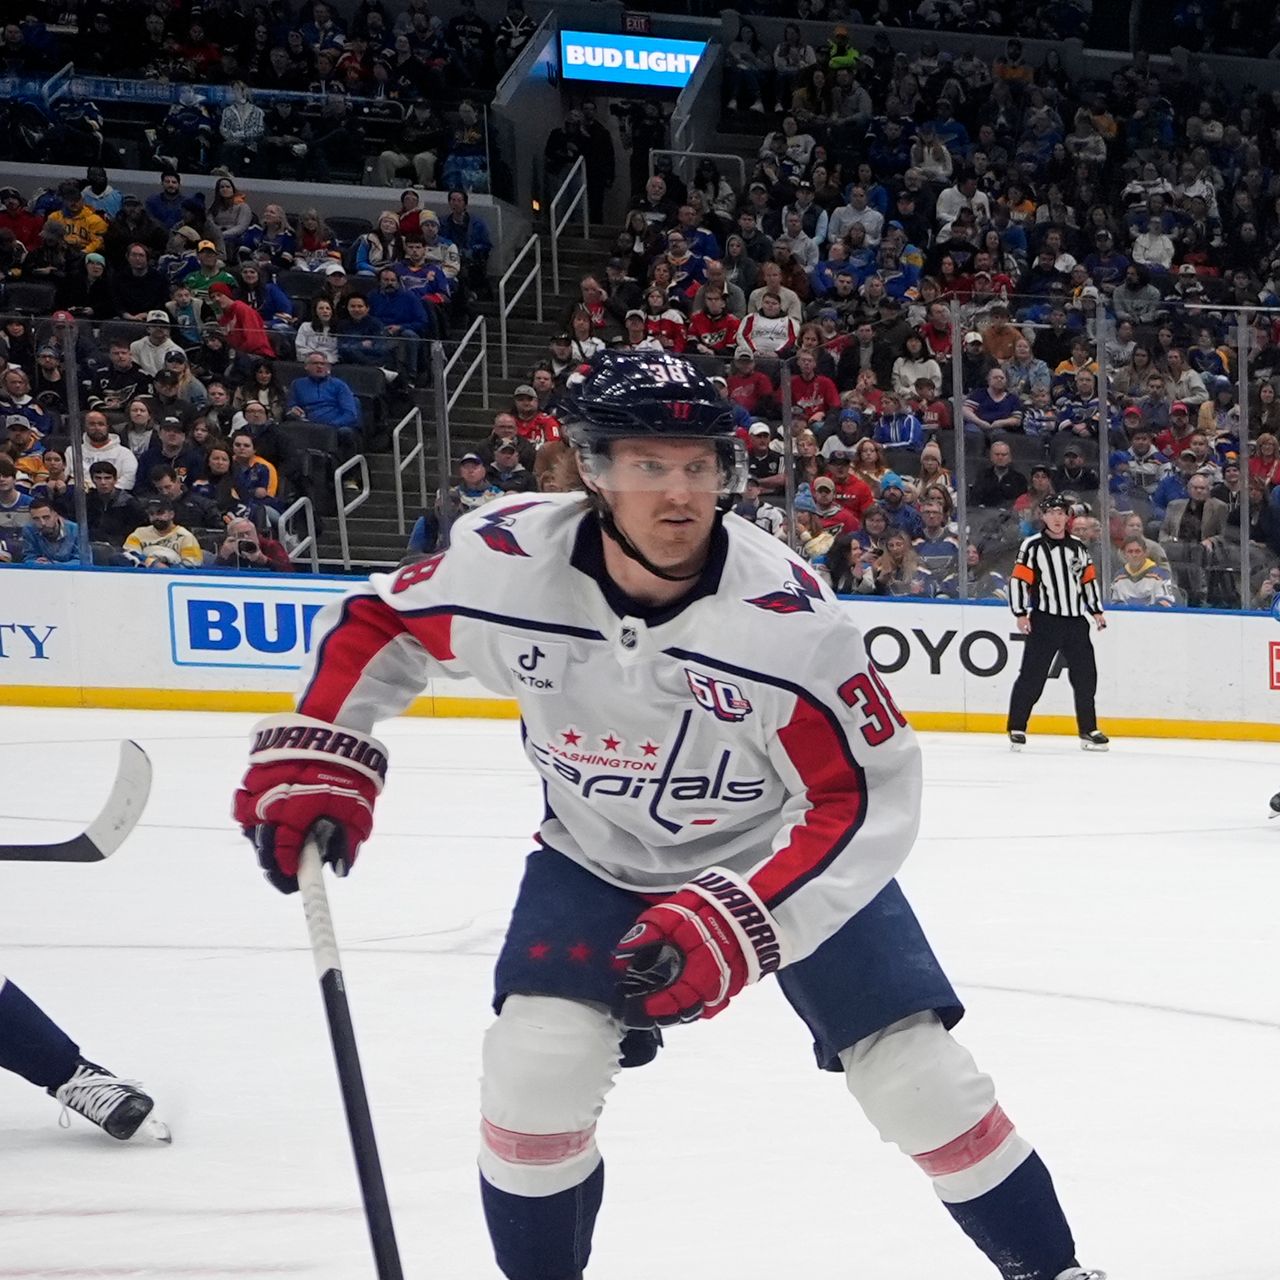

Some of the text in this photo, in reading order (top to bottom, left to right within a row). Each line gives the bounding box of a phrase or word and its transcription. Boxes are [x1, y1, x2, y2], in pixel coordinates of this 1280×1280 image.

[566, 45, 700, 74] BUD LIGHT
[649, 363, 688, 382] 38
[863, 626, 1060, 679] OYO
[684, 667, 752, 722] 50
[547, 742, 657, 771] WASHINGTON
[708, 916, 730, 945] COVERT
